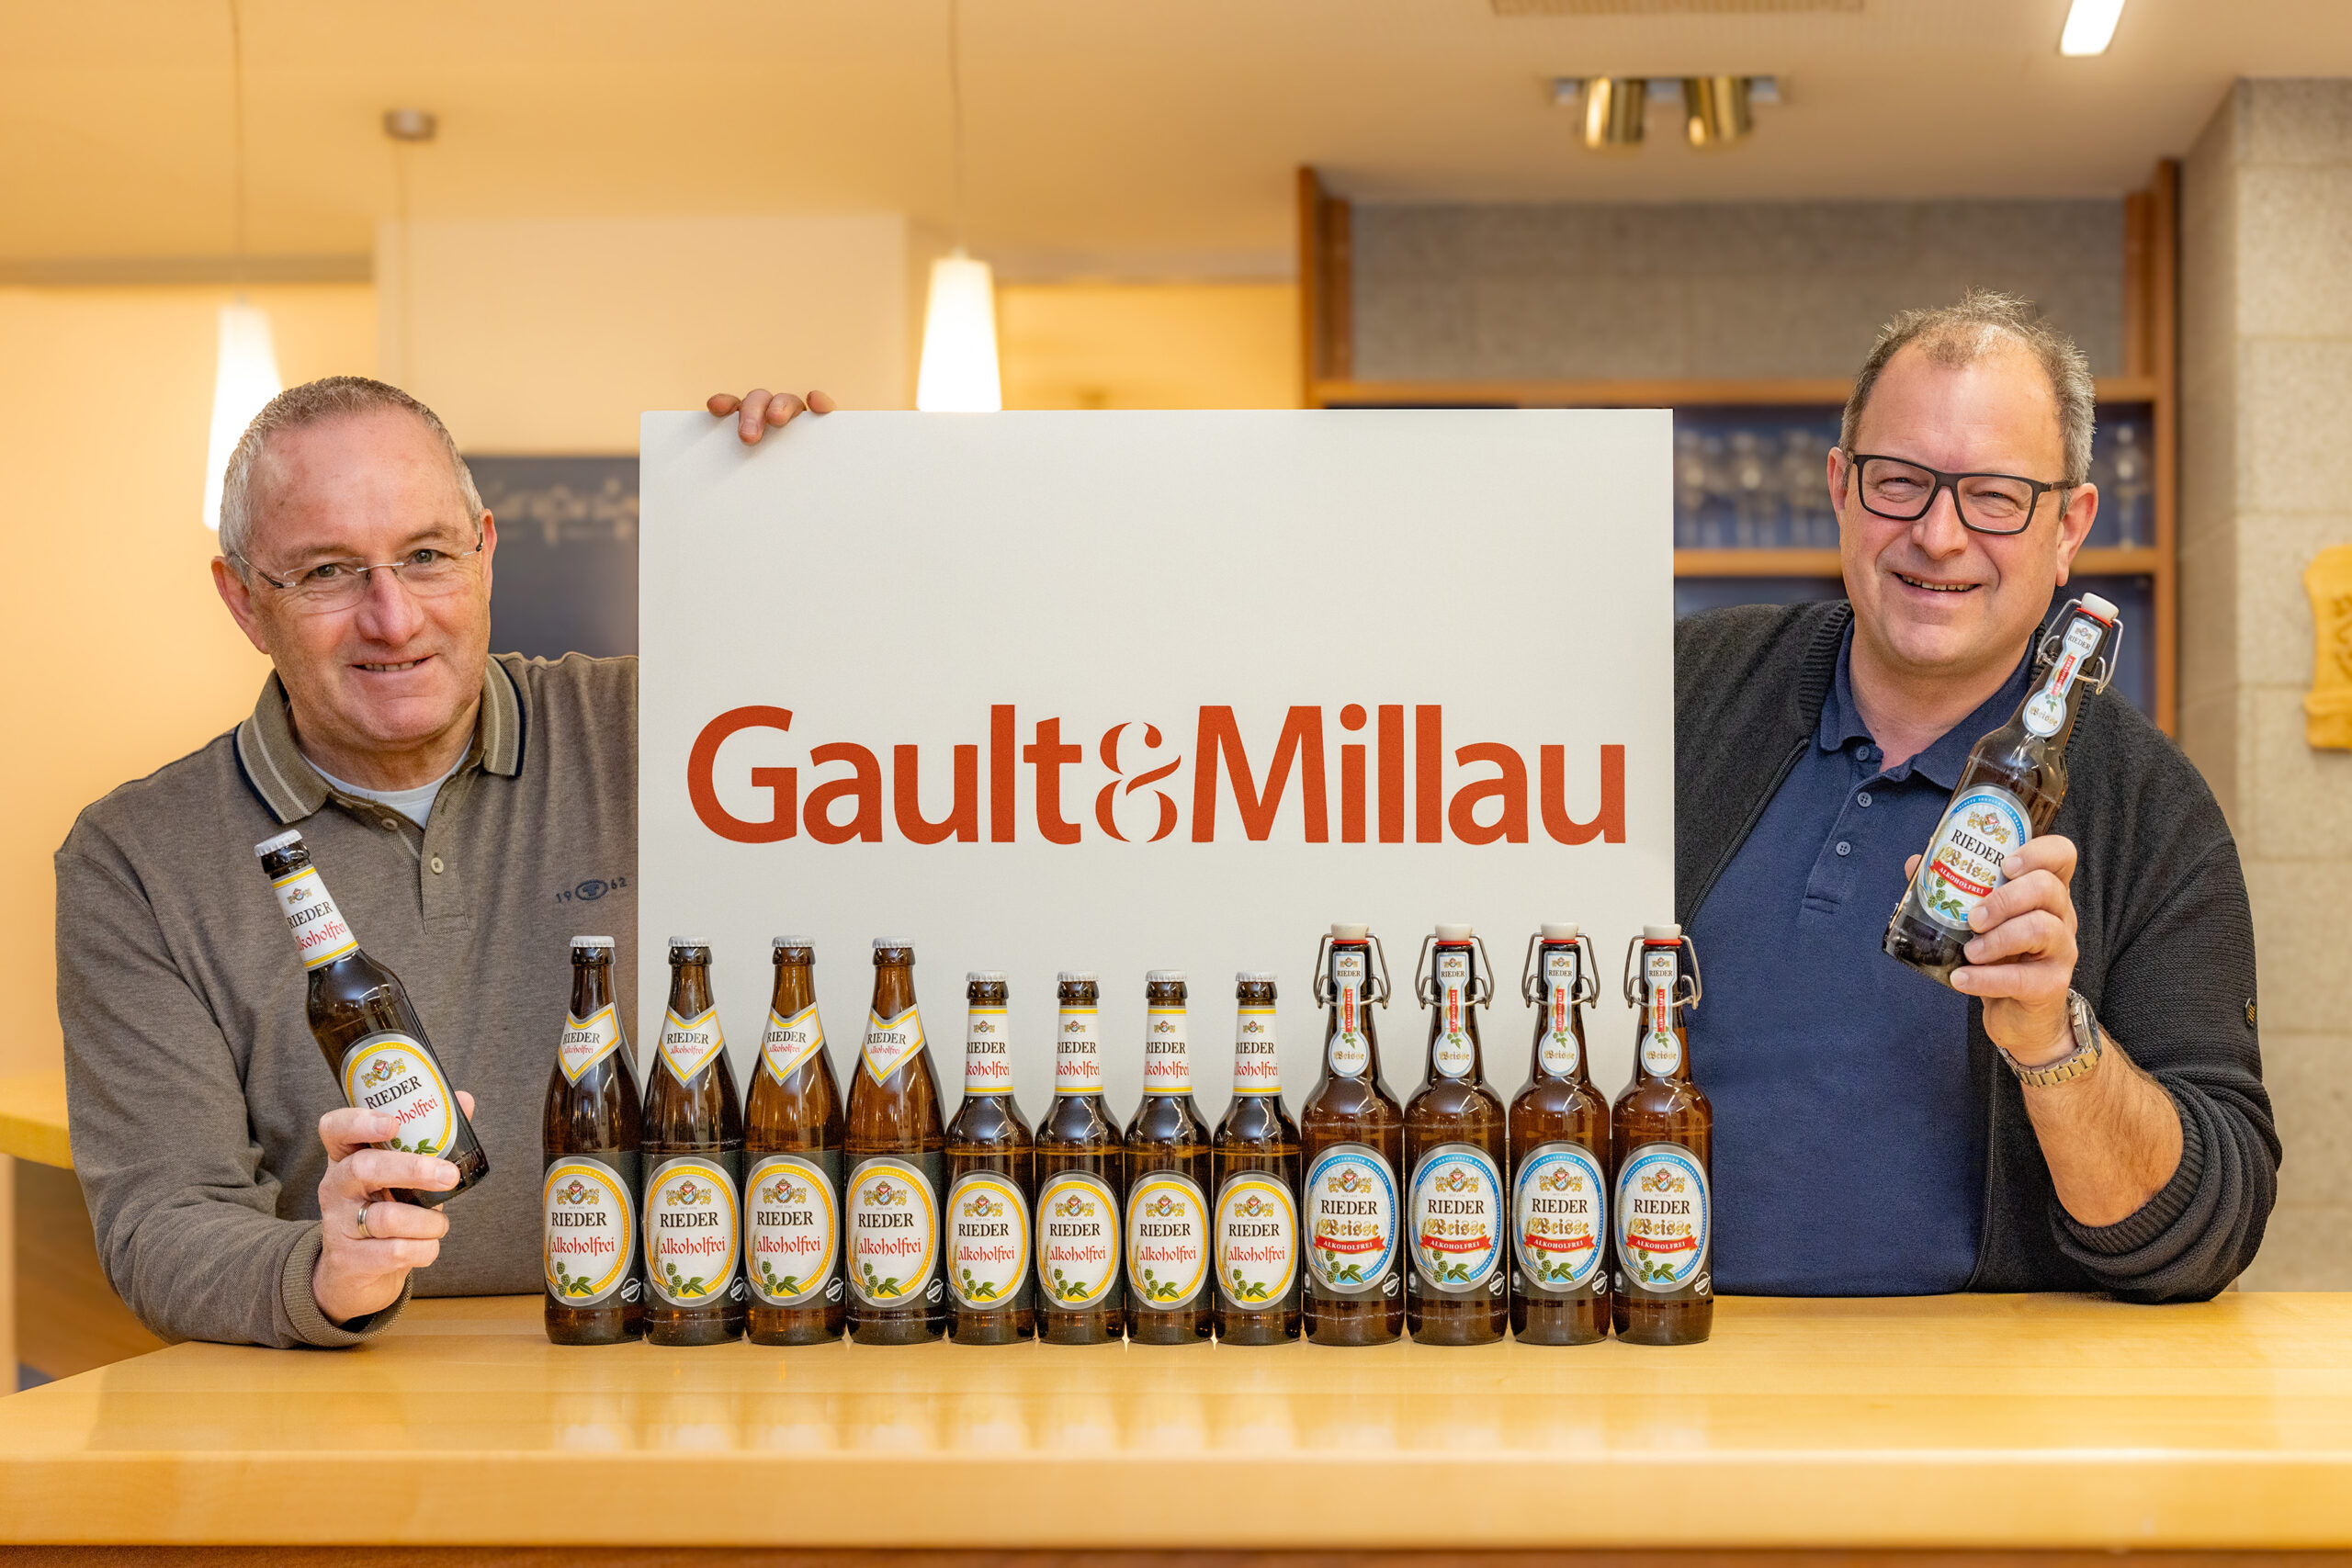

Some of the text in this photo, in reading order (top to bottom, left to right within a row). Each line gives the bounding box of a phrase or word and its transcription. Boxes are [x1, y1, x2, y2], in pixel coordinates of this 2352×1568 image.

[2067, 635, 2091, 650] RIEDER
[688, 704, 1625, 845] Gault&Millau
[1951, 829, 2005, 867] RIEDER
[1943, 847, 1996, 886] Weisse
[1939, 867, 1984, 895] ALKOHOLFREI
[556, 877, 628, 903] 19 62
[288, 901, 333, 928] RIEDER
[296, 922, 347, 952] lkoholfrei
[1548, 969, 1572, 977] RIEDER
[563, 1032, 600, 1044] RIEDER
[667, 1032, 708, 1044] RIEDER
[767, 1031, 806, 1044] RIEDER
[866, 1032, 906, 1045] RIEDER
[1334, 1051, 1363, 1060] Weisse
[1439, 1051, 1470, 1060] Weisse
[1544, 1051, 1575, 1060] Weisse
[1646, 1051, 1676, 1060] Weisse
[966, 1061, 1009, 1078] lkoholfrei
[1057, 1061, 1099, 1078] lkoholfrei
[1146, 1061, 1189, 1078] lkoholfrei
[1234, 1061, 1277, 1078] lkoholfrei
[364, 1077, 422, 1109] RIEDER
[1321, 1200, 1377, 1214] RIEDER
[1428, 1200, 1484, 1213] RIEDER
[1532, 1199, 1588, 1213] RIEDER
[1634, 1199, 1690, 1213] RIEDER
[551, 1213, 606, 1226] RIEDER
[661, 1213, 718, 1227] RIEDER
[757, 1212, 813, 1225] RIEDER
[858, 1213, 913, 1227] RIEDER
[958, 1224, 1009, 1236] RIEDER
[1050, 1224, 1100, 1236] RIEDER
[1140, 1224, 1190, 1236] RIEDER
[1229, 1224, 1279, 1236] RIEDER
[1321, 1218, 1378, 1235] Weisse
[1429, 1218, 1486, 1235] Weisse
[1532, 1217, 1589, 1235] Weisse
[1634, 1218, 1690, 1235] Weisse
[552, 1236, 614, 1257] alkoholfrei
[662, 1236, 725, 1256] alkoholfrei
[757, 1235, 820, 1255] alkoholfrei
[859, 1237, 921, 1257] alkoholfrei
[1323, 1240, 1373, 1251] ALKOHOLFREI
[1430, 1240, 1480, 1250] ALKOHOLFREI
[1534, 1238, 1583, 1249] ALKOHOLFREI
[1636, 1240, 1686, 1250] ALKOHOLFREI
[958, 1246, 1014, 1263] alkoholfrei
[1050, 1246, 1105, 1263] alkoholfrei
[1140, 1246, 1196, 1263] alkoholfrei
[1228, 1247, 1284, 1263] alkoholfrei
